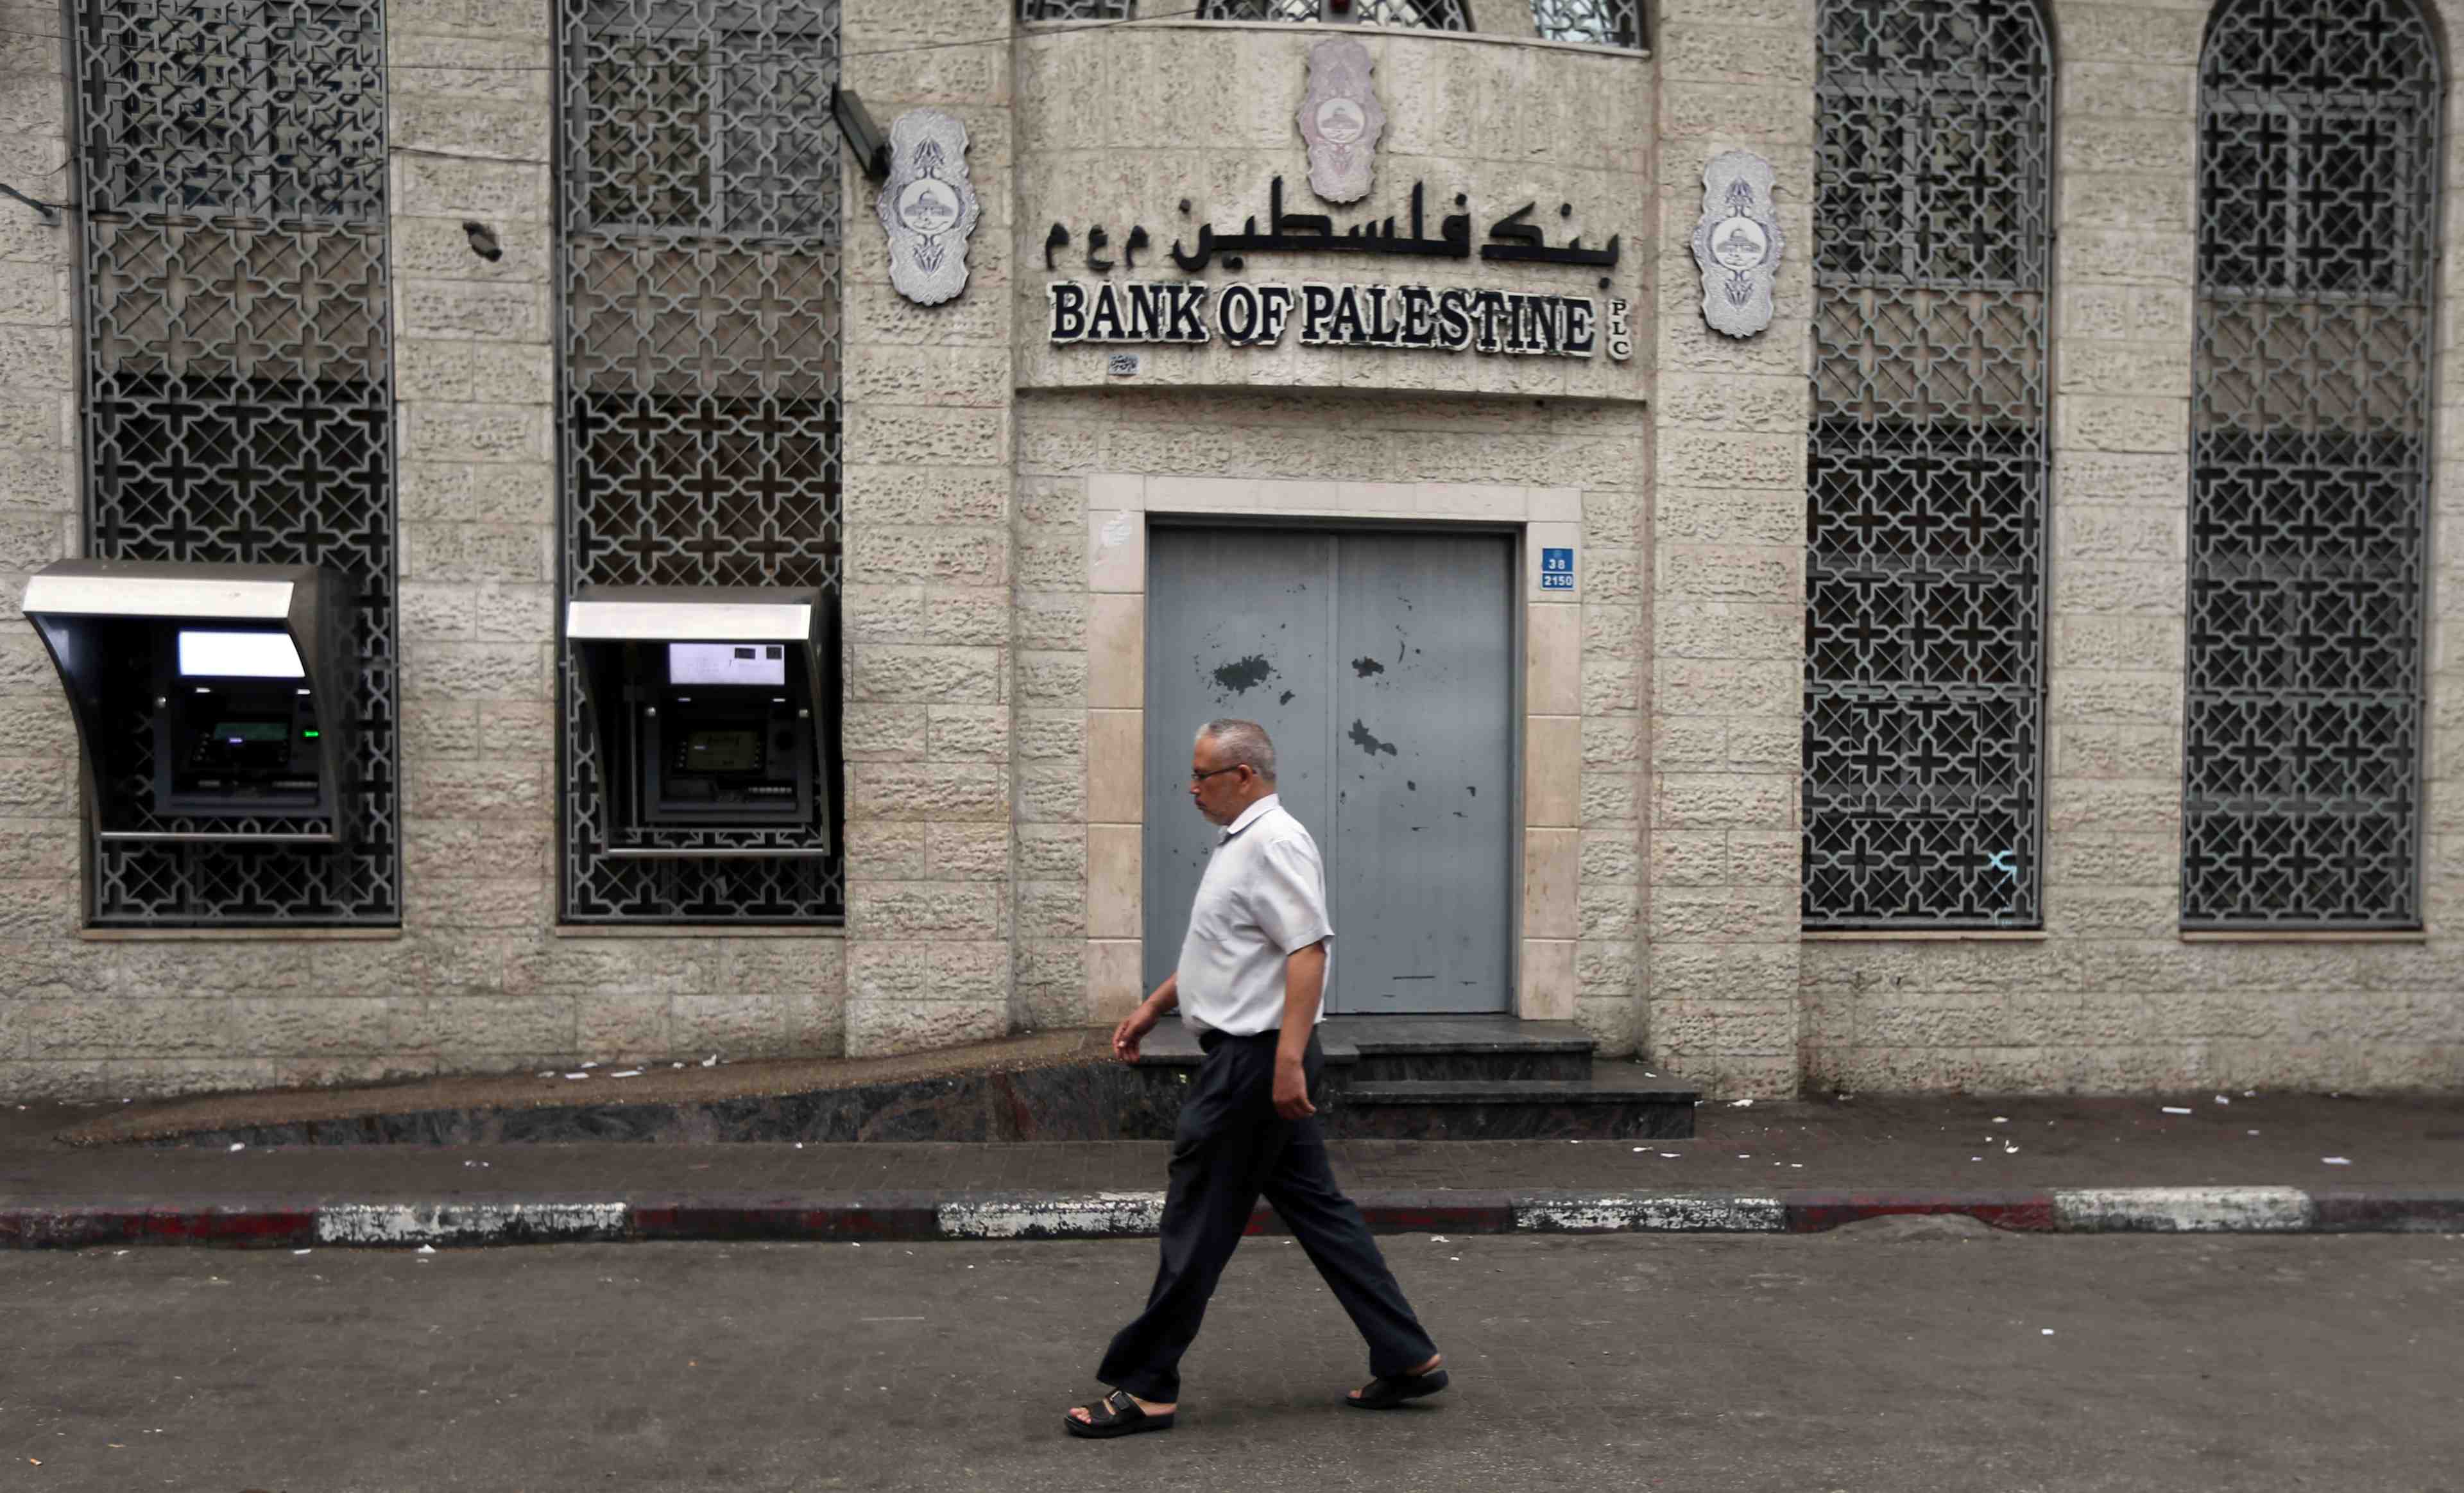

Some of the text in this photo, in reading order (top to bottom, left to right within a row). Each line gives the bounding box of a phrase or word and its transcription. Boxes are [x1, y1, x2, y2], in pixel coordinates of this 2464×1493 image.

[1170, 175, 1471, 273] فلسطين
[1480, 201, 1619, 289] بنك
[1050, 282, 1596, 356] BANK OF PALESTINE
[1611, 300, 1632, 356] PLC
[1544, 575, 1572, 586] 2150
